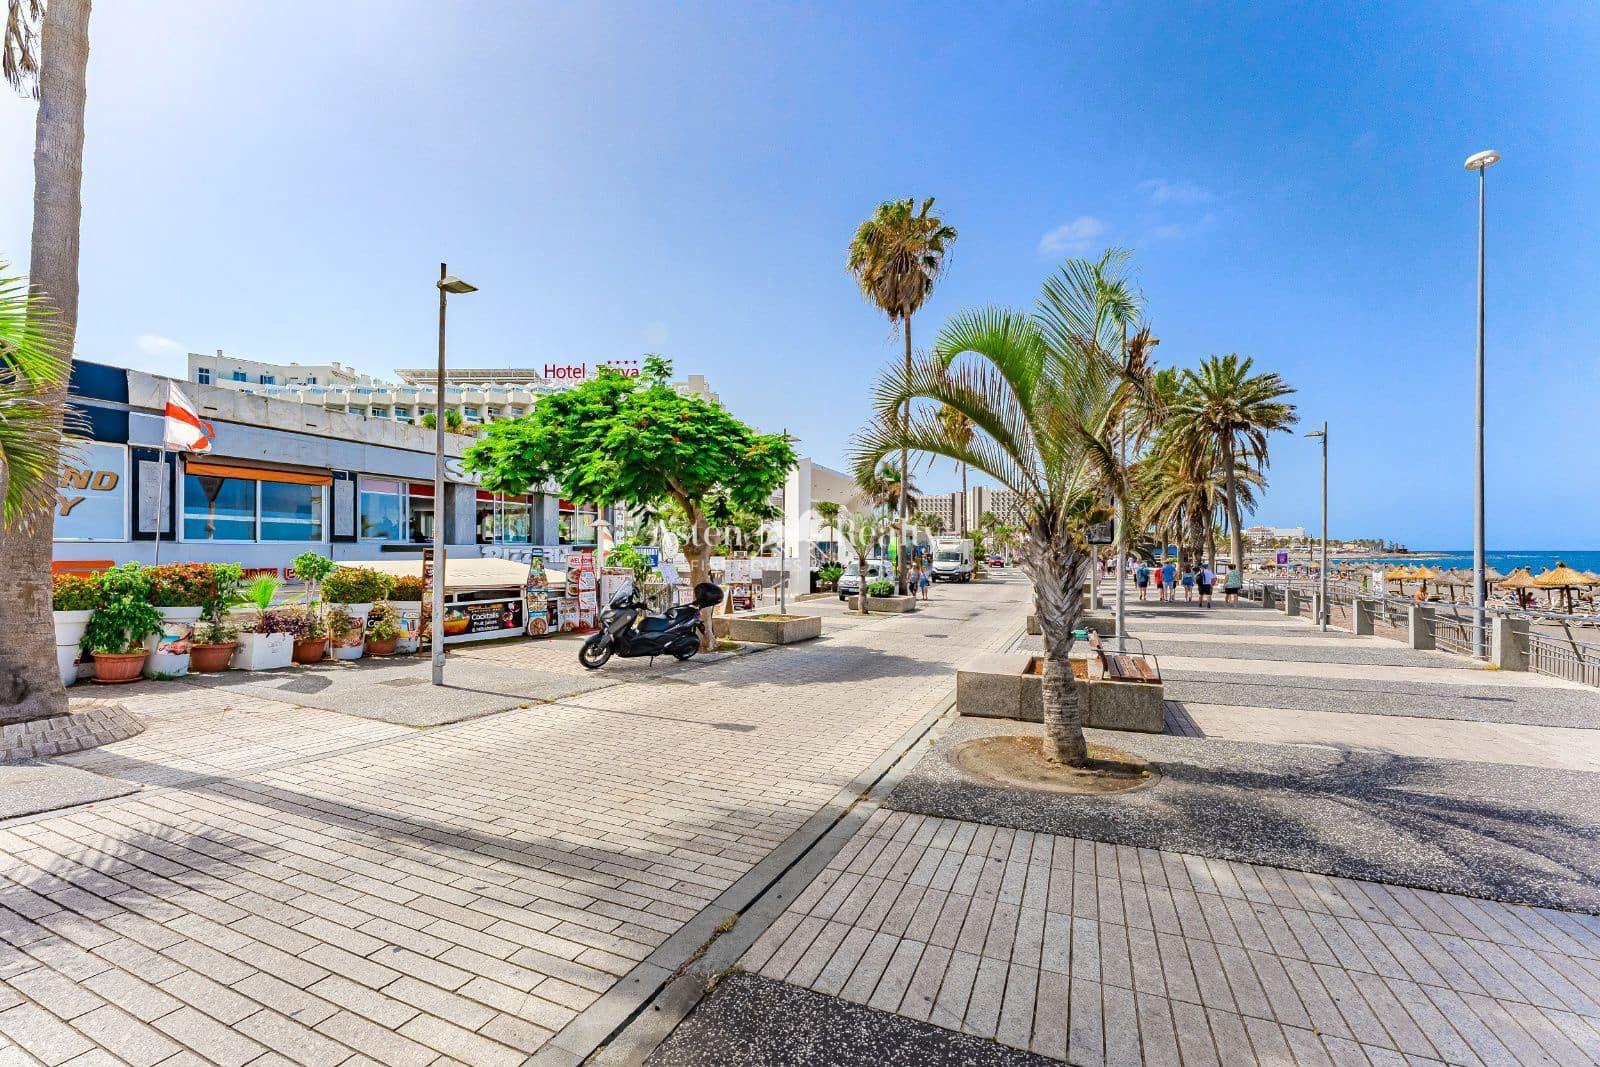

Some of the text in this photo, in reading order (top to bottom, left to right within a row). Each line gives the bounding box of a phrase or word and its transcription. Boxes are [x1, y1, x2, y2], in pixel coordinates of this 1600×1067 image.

[544, 362, 586, 379] Hotel
[59, 469, 119, 491] ND
[54, 494, 87, 516] Y
[471, 611, 500, 620] Cocktails
